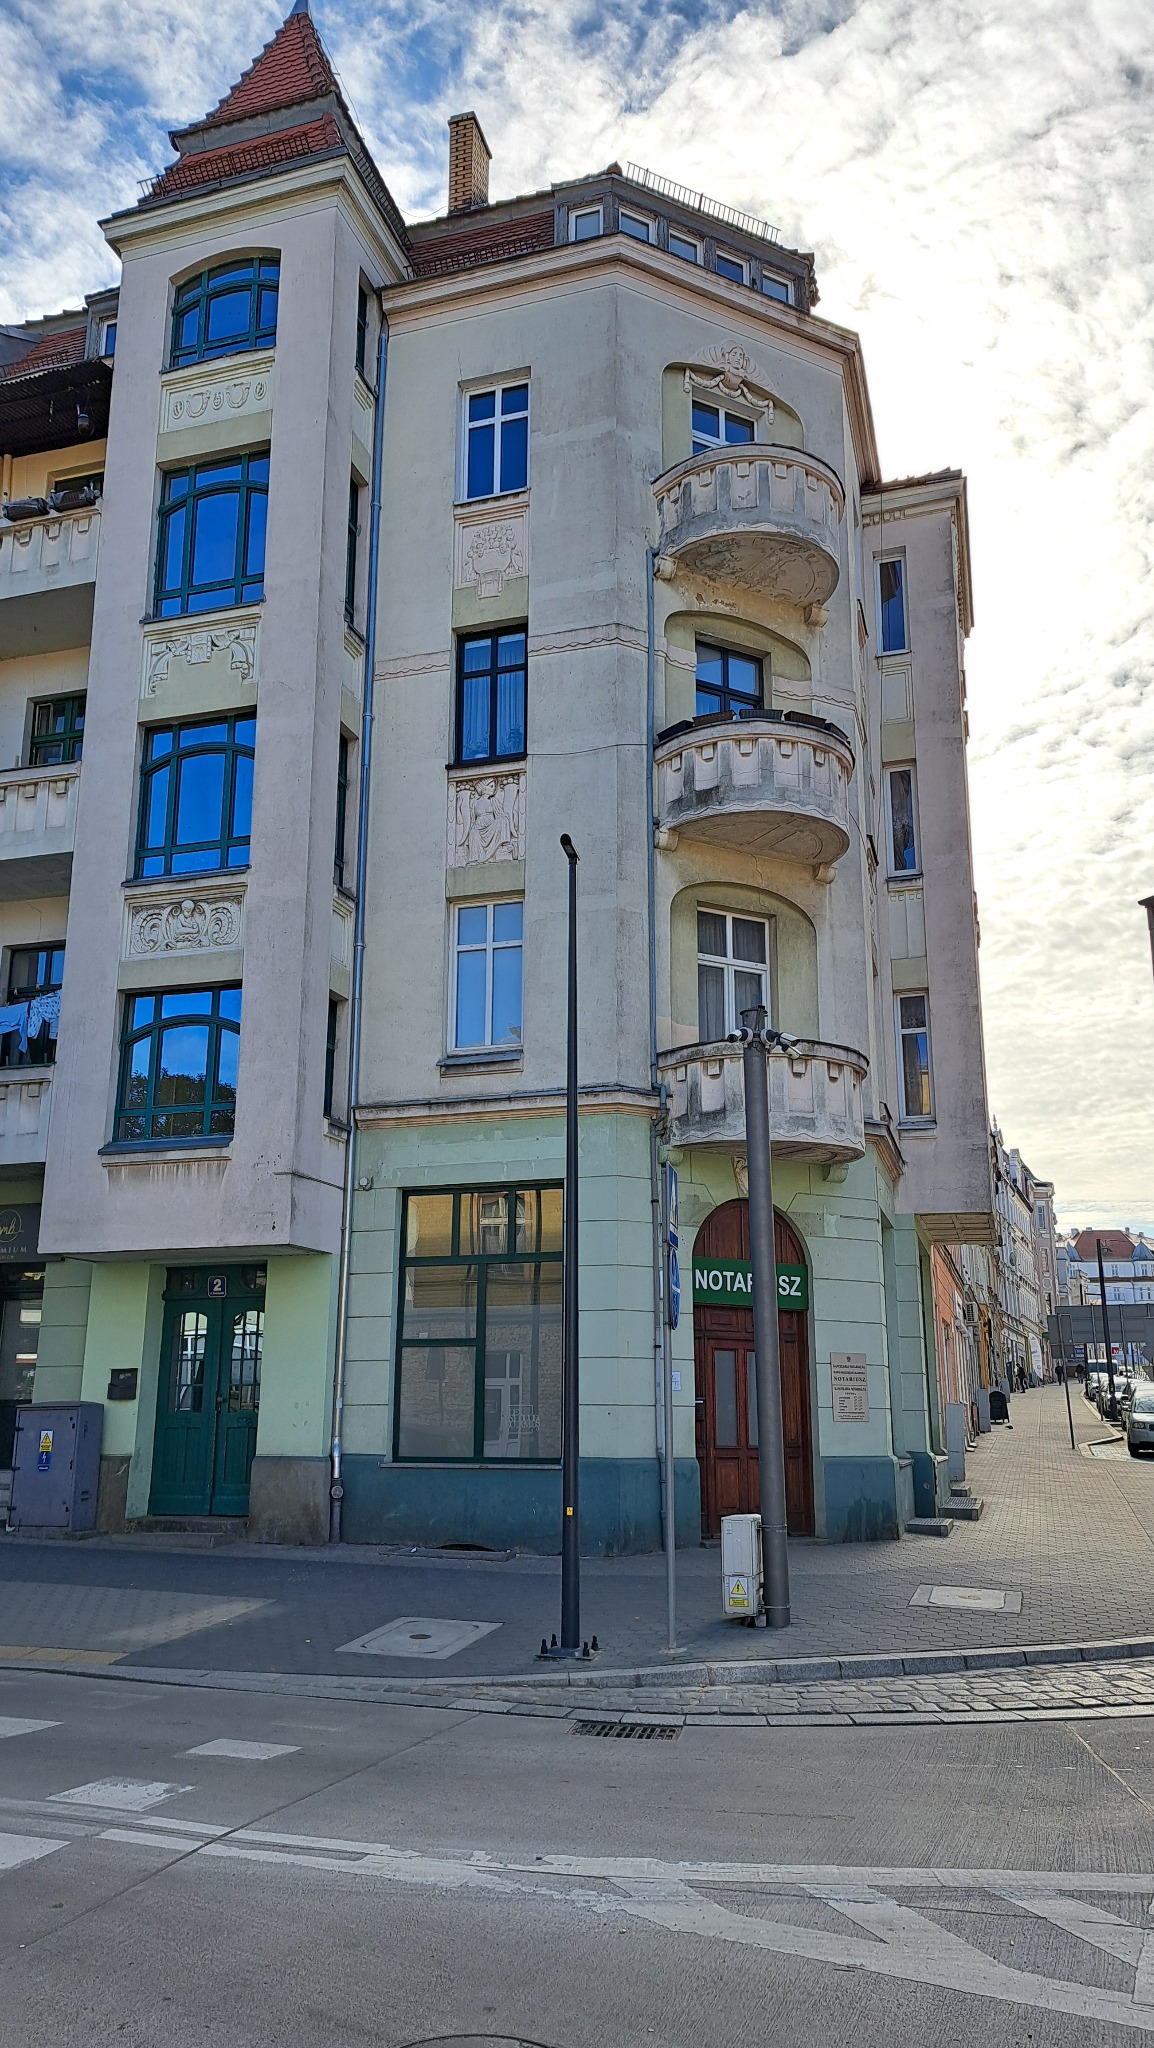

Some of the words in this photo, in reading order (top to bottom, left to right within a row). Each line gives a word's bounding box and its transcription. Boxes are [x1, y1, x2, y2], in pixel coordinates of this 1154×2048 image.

[0, 1246, 27, 1254] MIUM
[213, 1278, 222, 1292] 2
[695, 1269, 802, 1297] NOTASZ
